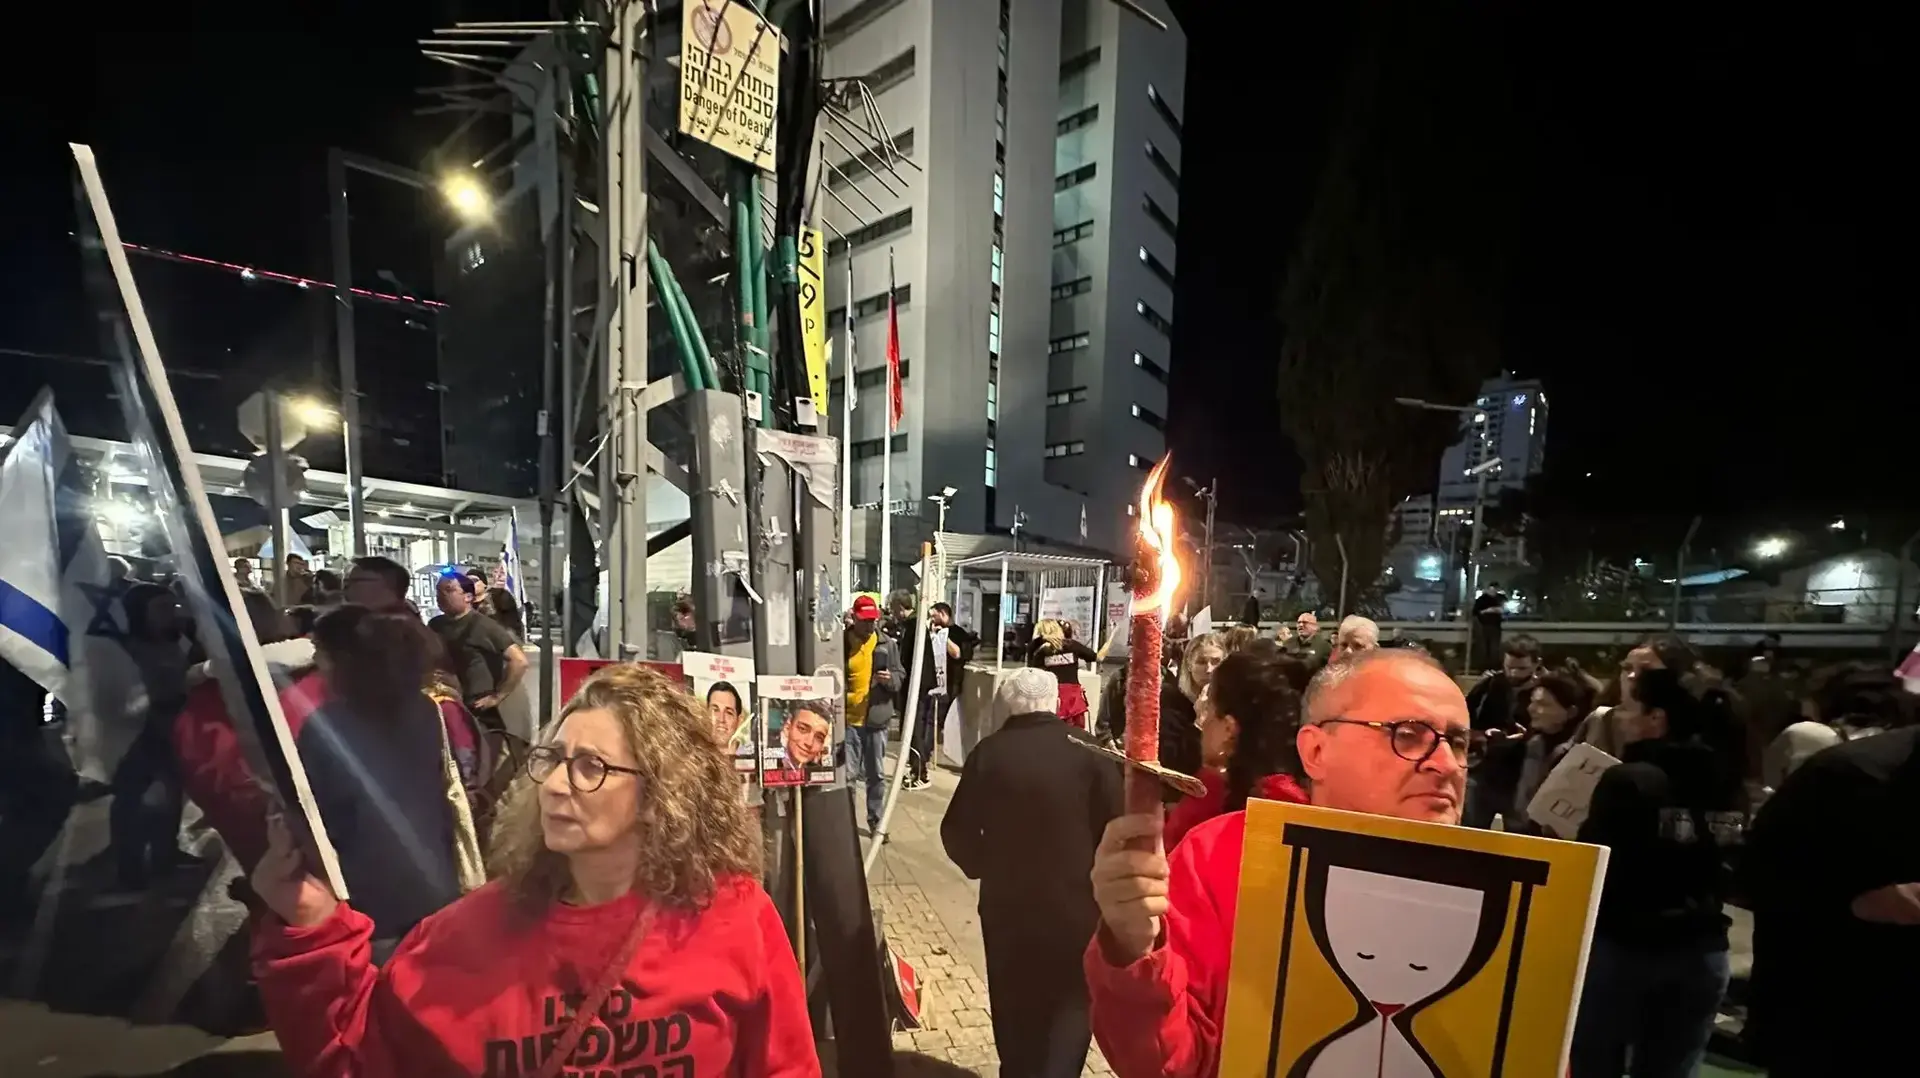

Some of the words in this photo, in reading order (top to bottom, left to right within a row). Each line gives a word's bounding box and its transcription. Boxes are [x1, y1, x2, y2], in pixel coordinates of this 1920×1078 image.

[741, 70, 774, 101] מתח
[684, 85, 724, 115] Danger
[726, 108, 738, 123] of
[740, 111, 773, 139] Death!
[734, 87, 774, 119] סכנת
